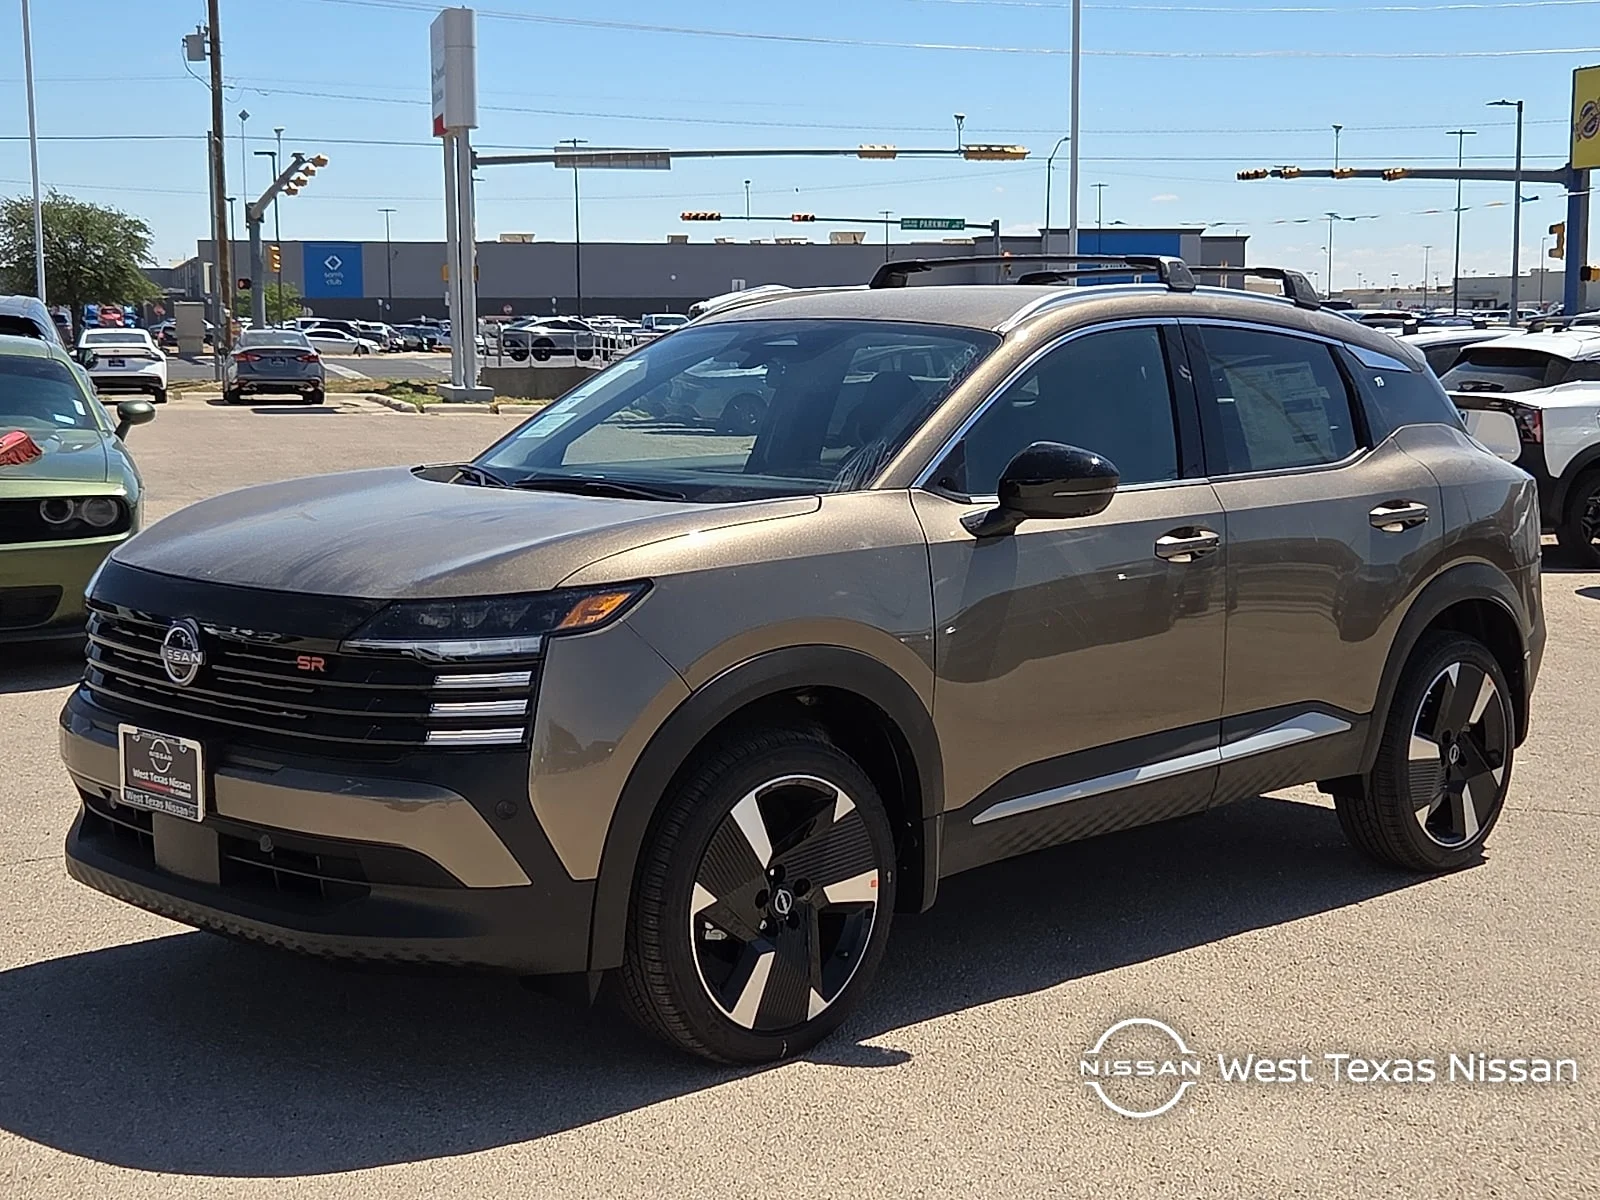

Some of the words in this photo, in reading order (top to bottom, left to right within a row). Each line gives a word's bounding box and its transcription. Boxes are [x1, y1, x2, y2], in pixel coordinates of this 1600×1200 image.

[919, 219, 950, 229] PARKWAY
[161, 647, 201, 663] SSAN
[297, 655, 325, 672] SR
[148, 750, 173, 762] NISSAN
[132, 767, 149, 780] West
[149, 772, 168, 785] Texas
[168, 776, 192, 791] Nissan
[126, 790, 144, 804] West
[144, 795, 164, 809] Texas
[164, 800, 188, 816] Nissan
